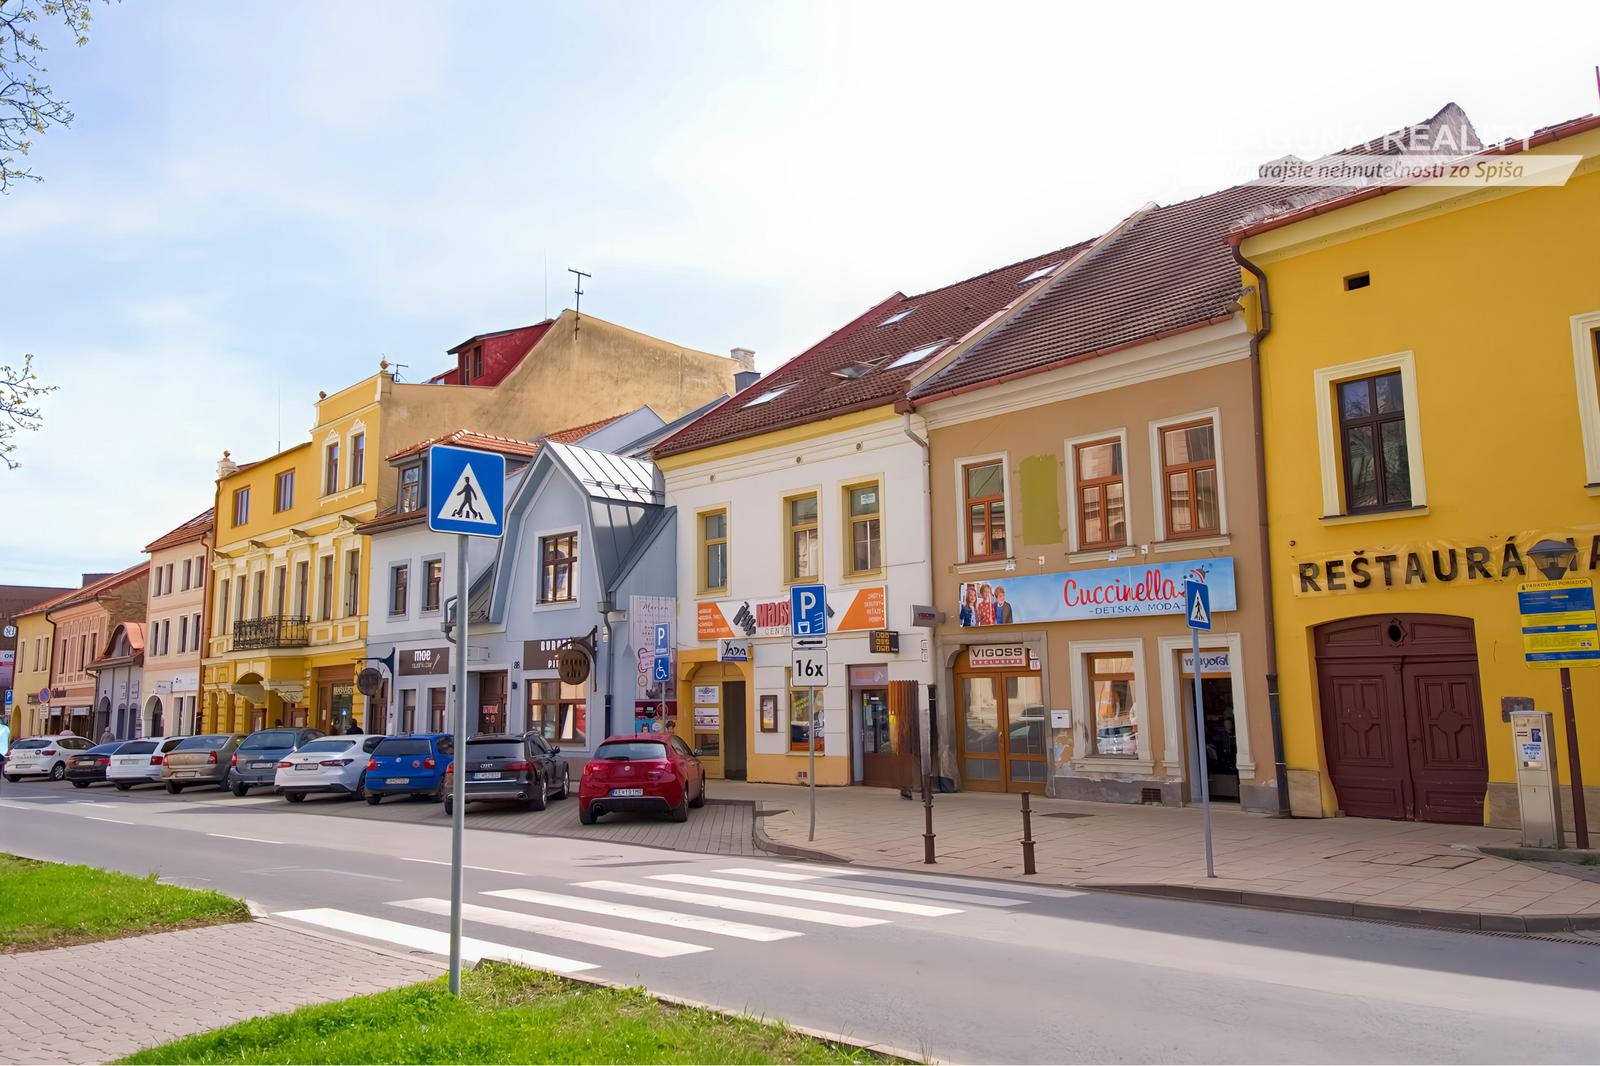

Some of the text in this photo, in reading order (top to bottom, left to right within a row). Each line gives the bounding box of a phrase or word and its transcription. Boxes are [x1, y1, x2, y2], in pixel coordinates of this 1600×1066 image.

[1063, 569, 1177, 607] Cuccinella
[801, 591, 816, 619] P
[764, 626, 791, 635] CENTR
[972, 647, 1023, 658] VIGOSS
[796, 659, 824, 677] 16x
